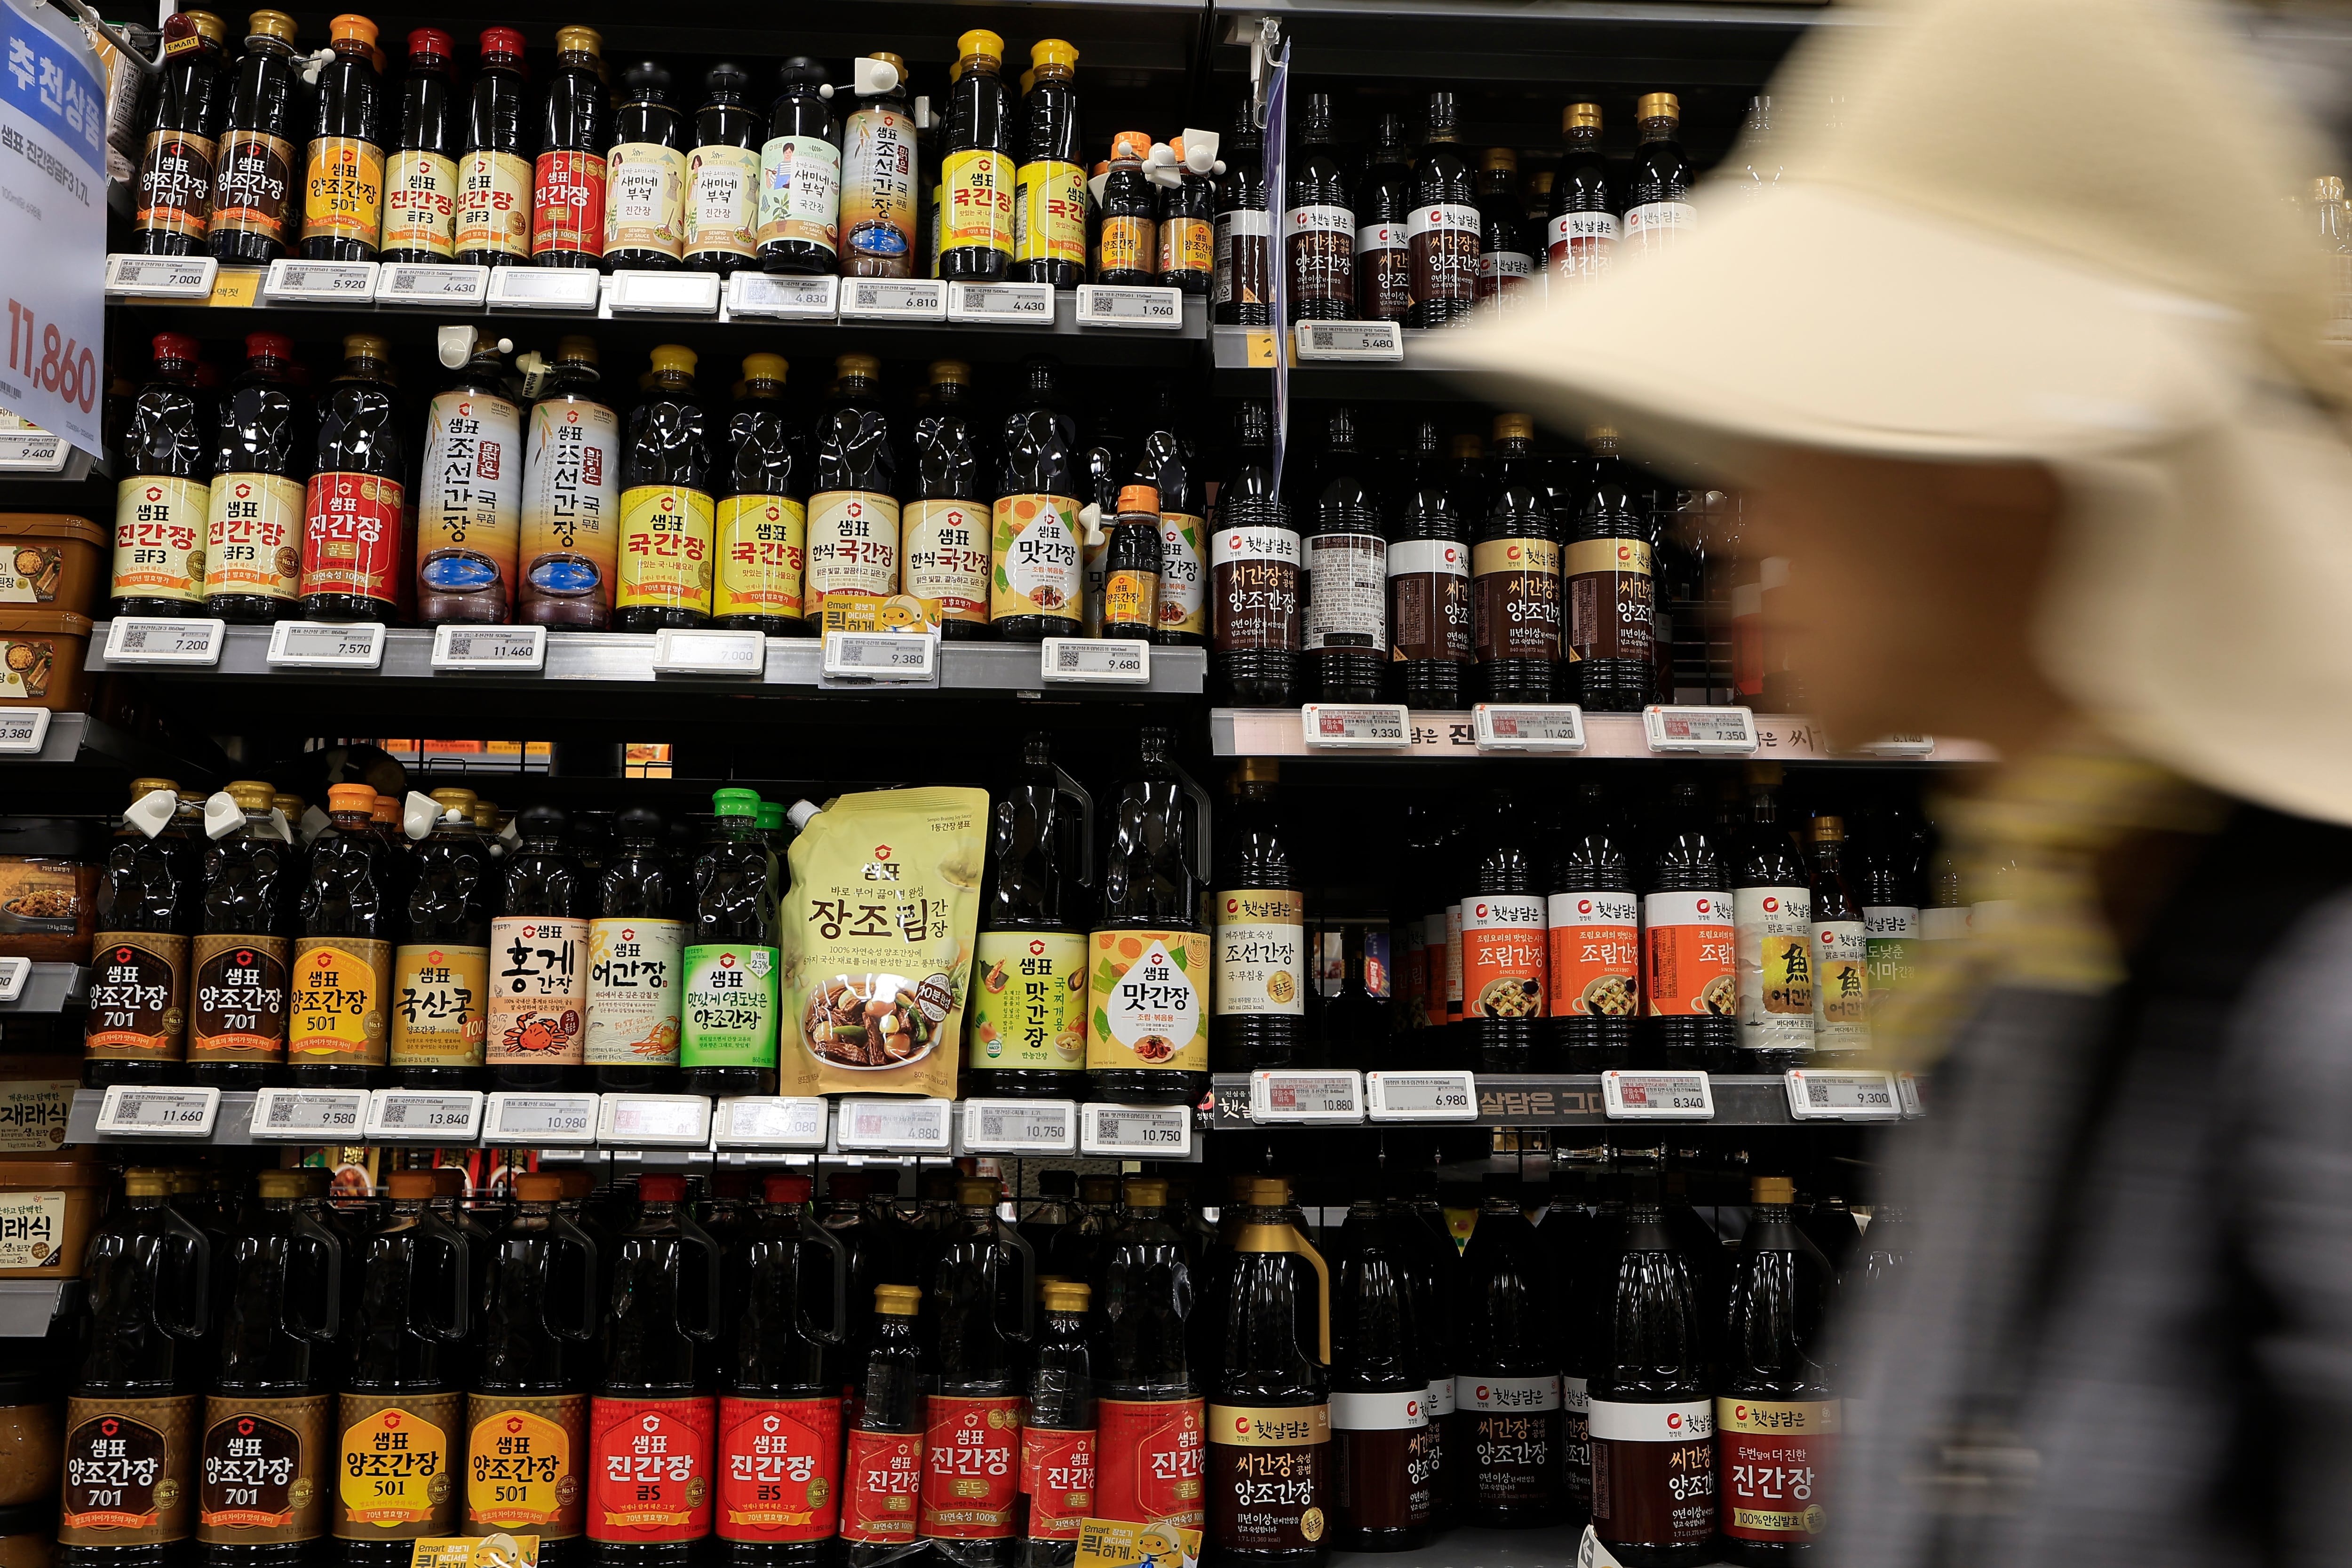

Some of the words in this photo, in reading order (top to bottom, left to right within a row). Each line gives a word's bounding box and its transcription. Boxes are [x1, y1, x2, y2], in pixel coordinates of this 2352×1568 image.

[8, 36, 101, 152] 추천상품
[1, 124, 24, 155] 샘표
[143, 172, 209, 199] 양조간장
[621, 175, 658, 188] 새미네
[872, 141, 895, 219] 조선간장
[311, 176, 377, 205] 양조간장
[626, 188, 651, 201] 부엌
[156, 192, 183, 206] 701
[331, 198, 357, 212] 501
[390, 190, 453, 216] 진간장
[800, 200, 824, 213] 국간장
[954, 188, 1012, 213] 국간장
[625, 206, 651, 216] 진간장
[1310, 213, 1348, 231] 햇살담은
[1104, 239, 1136, 251] 양조간장
[1295, 255, 1351, 276] 양조간장
[169, 274, 201, 285] 7,000
[333, 279, 366, 289] 5,920
[795, 294, 827, 303] 4,830
[906, 298, 938, 308] 6,810
[1142, 305, 1173, 315] 1,960
[1362, 339, 1393, 348] 5,480
[8, 298, 95, 414] 11,860
[21, 448, 55, 459] 9,400
[443, 437, 475, 543] 조선간장
[477, 490, 497, 509] 국
[136, 504, 169, 522] 샘표
[476, 513, 496, 525] 무침
[309, 515, 383, 542] 진간장
[837, 520, 869, 537] 샘표
[117, 524, 197, 550] 진간장
[628, 533, 706, 561] 국간장
[812, 544, 835, 562] 한식
[836, 539, 894, 568] 국간장
[1018, 540, 1076, 566] 맛간장
[1245, 537, 1292, 555] 햇살담은
[134, 549, 167, 564] 금F3
[144, 574, 169, 584] 발효명가
[916, 575, 928, 584] 맑은
[943, 575, 969, 585] 깔끔하고
[969, 577, 980, 586] 깊은
[1230, 565, 1282, 587] 씨간장
[1282, 570, 1294, 579] 숙성
[1282, 578, 1294, 589] 공법
[827, 601, 852, 610] emart
[854, 603, 875, 611] 장보기
[1229, 590, 1296, 614] 양조간장
[175, 640, 208, 651] 7,200
[338, 644, 371, 654] 7,570
[493, 646, 533, 657] 11,460
[892, 654, 924, 664] 9,380
[1109, 660, 1140, 669] 9,680
[1371, 728, 1401, 738] 9,330
[1544, 729, 1573, 739] 11,420
[1716, 731, 1746, 740] 7,350
[931, 822, 956, 832] 1등간장
[957, 820, 970, 829] 샘표
[1242, 901, 1291, 918] 햇살담은
[1492, 905, 1539, 923] 햇살담은
[809, 899, 928, 942] 장조림
[851, 947, 882, 956] 자연숙성
[884, 948, 922, 957] 양조간장에
[1225, 942, 1295, 965] 조선간장
[1477, 945, 1544, 968] 조림간장
[501, 937, 575, 993] 홍게
[752, 960, 769, 970] 25%
[837, 957, 859, 966] 재료를
[862, 958, 877, 967] 더해
[879, 959, 902, 967] 완성한
[905, 959, 919, 967] 깊고
[921, 958, 944, 968] 풍부한
[944, 960, 950, 968] 맛
[1018, 958, 1052, 976] 샘표
[1781, 943, 1809, 984] 魚
[225, 969, 260, 986] 샘표
[592, 962, 667, 988] 어간장
[1227, 970, 1265, 981] 국·무침용
[538, 976, 573, 995] 간장
[1272, 980, 1292, 995] 골드
[199, 986, 283, 1013] 양조간장
[291, 989, 368, 1015] 양조간장
[688, 992, 721, 1008] 맛있게
[723, 992, 767, 1008] 염도낮은
[1122, 984, 1190, 1011] 맛간장
[396, 987, 475, 1026] 국산콩
[223, 1014, 256, 1030] 701
[694, 1009, 762, 1030] 양조간장
[1023, 981, 1050, 1049] 맛간장
[1136, 1013, 1174, 1022] 조림·볶음용
[306, 1016, 335, 1031] 501
[407, 1025, 436, 1035] 양조간장
[209, 1037, 227, 1047] 발효의
[227, 1035, 246, 1044] 차이가
[246, 1036, 258, 1045] 맛의
[259, 1038, 270, 1047] 차이
[1021, 1051, 1048, 1061] 만능간장
[1323, 1100, 1352, 1110] 10,880
[1436, 1095, 1467, 1106] 6,980
[1673, 1097, 1703, 1108] 8,340
[1857, 1092, 1889, 1104] 9,300
[1, 1102, 67, 1126] 재래식
[162, 1110, 204, 1123] 11,660
[322, 1113, 356, 1124] 9,580
[429, 1114, 469, 1125] 13,840
[547, 1117, 587, 1129] 10,980
[908, 1128, 939, 1139] 4,880
[1026, 1126, 1065, 1138] 10,750
[1143, 1129, 1180, 1142] 10,750
[1254, 1420, 1310, 1440] 햇살담은
[1476, 1441, 1548, 1465] 양조간장
[1772, 1449, 1783, 1460] 더
[1785, 1449, 1806, 1462] 진한
[347, 1451, 439, 1477] 양조간장
[606, 1454, 694, 1482] 진간장
[930, 1447, 1011, 1476] 진간장
[1235, 1452, 1295, 1478] 씨간장
[69, 1457, 159, 1486] 양조간장
[373, 1480, 405, 1497] 501
[955, 1480, 984, 1496] 골드
[1732, 1465, 1815, 1500] 진간장
[87, 1489, 122, 1506] 701
[636, 1485, 661, 1501] 금S
[1235, 1479, 1314, 1506] 양조간장
[939, 1511, 973, 1522] 자연숙성
[975, 1511, 997, 1523] 100%
[1249, 1525, 1277, 1534] 숙성합니다
